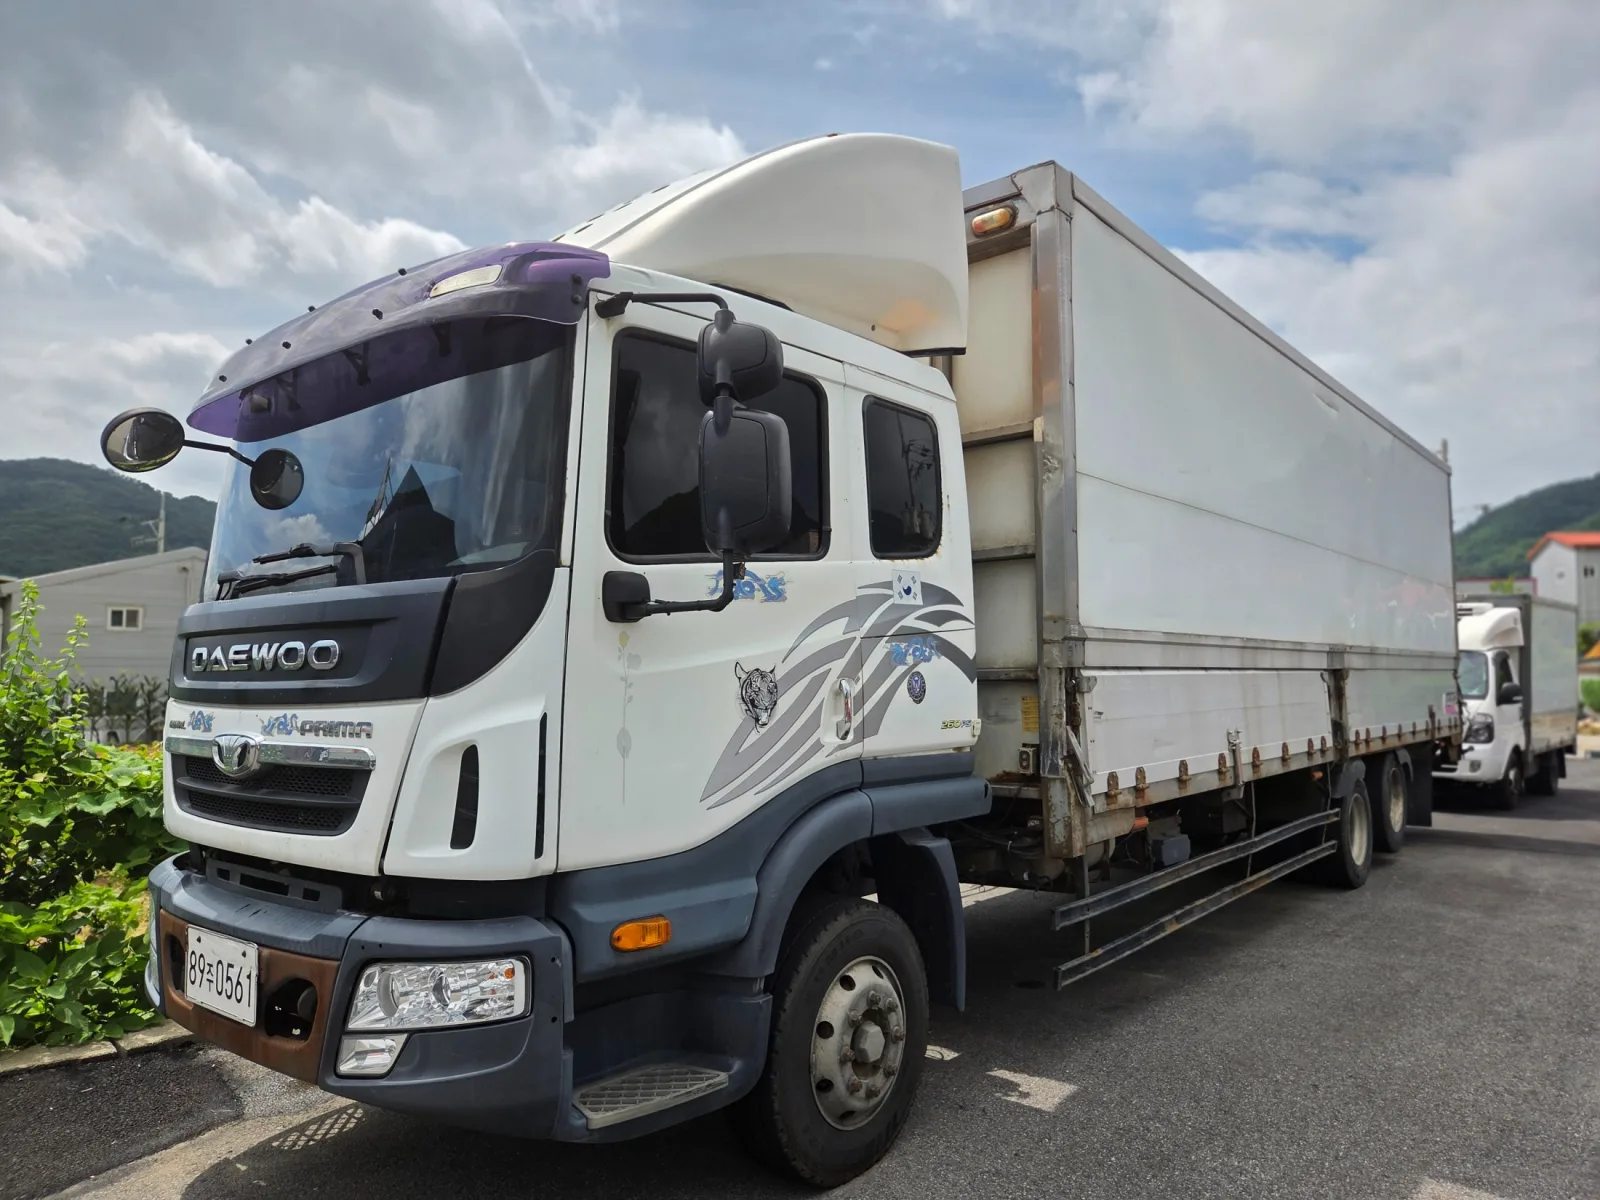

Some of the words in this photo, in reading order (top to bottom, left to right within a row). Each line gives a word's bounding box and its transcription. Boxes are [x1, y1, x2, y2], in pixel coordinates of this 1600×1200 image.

[191, 639, 340, 672] DAEWOO
[300, 720, 374, 739] PRIMA
[188, 950, 252, 1008] 89주0561
